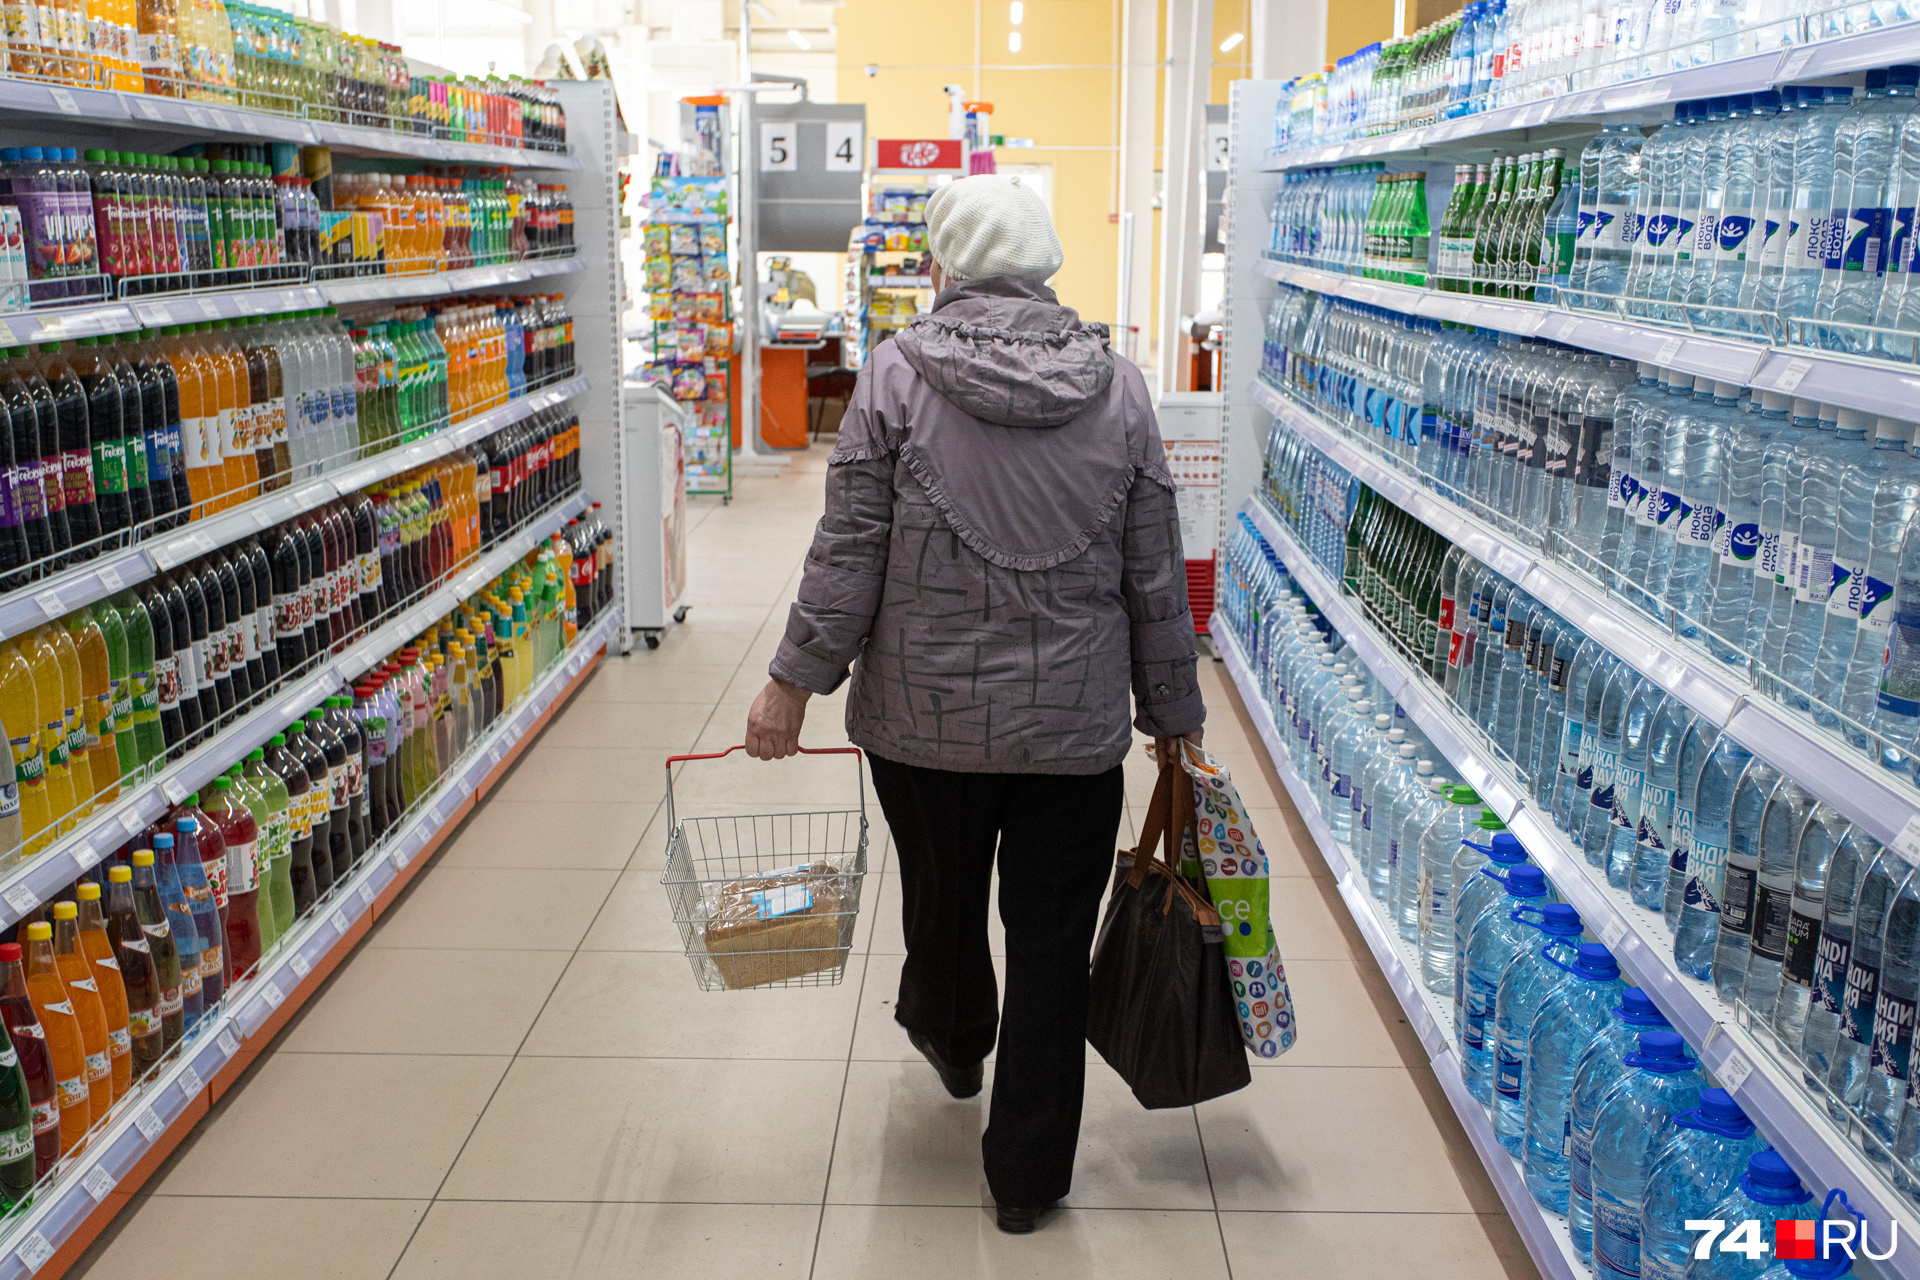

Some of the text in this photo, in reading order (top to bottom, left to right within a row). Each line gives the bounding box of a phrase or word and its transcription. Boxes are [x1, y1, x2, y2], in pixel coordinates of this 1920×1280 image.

[770, 137, 787, 163] 5
[835, 137, 853, 163] 4
[1214, 899, 1250, 920] ce
